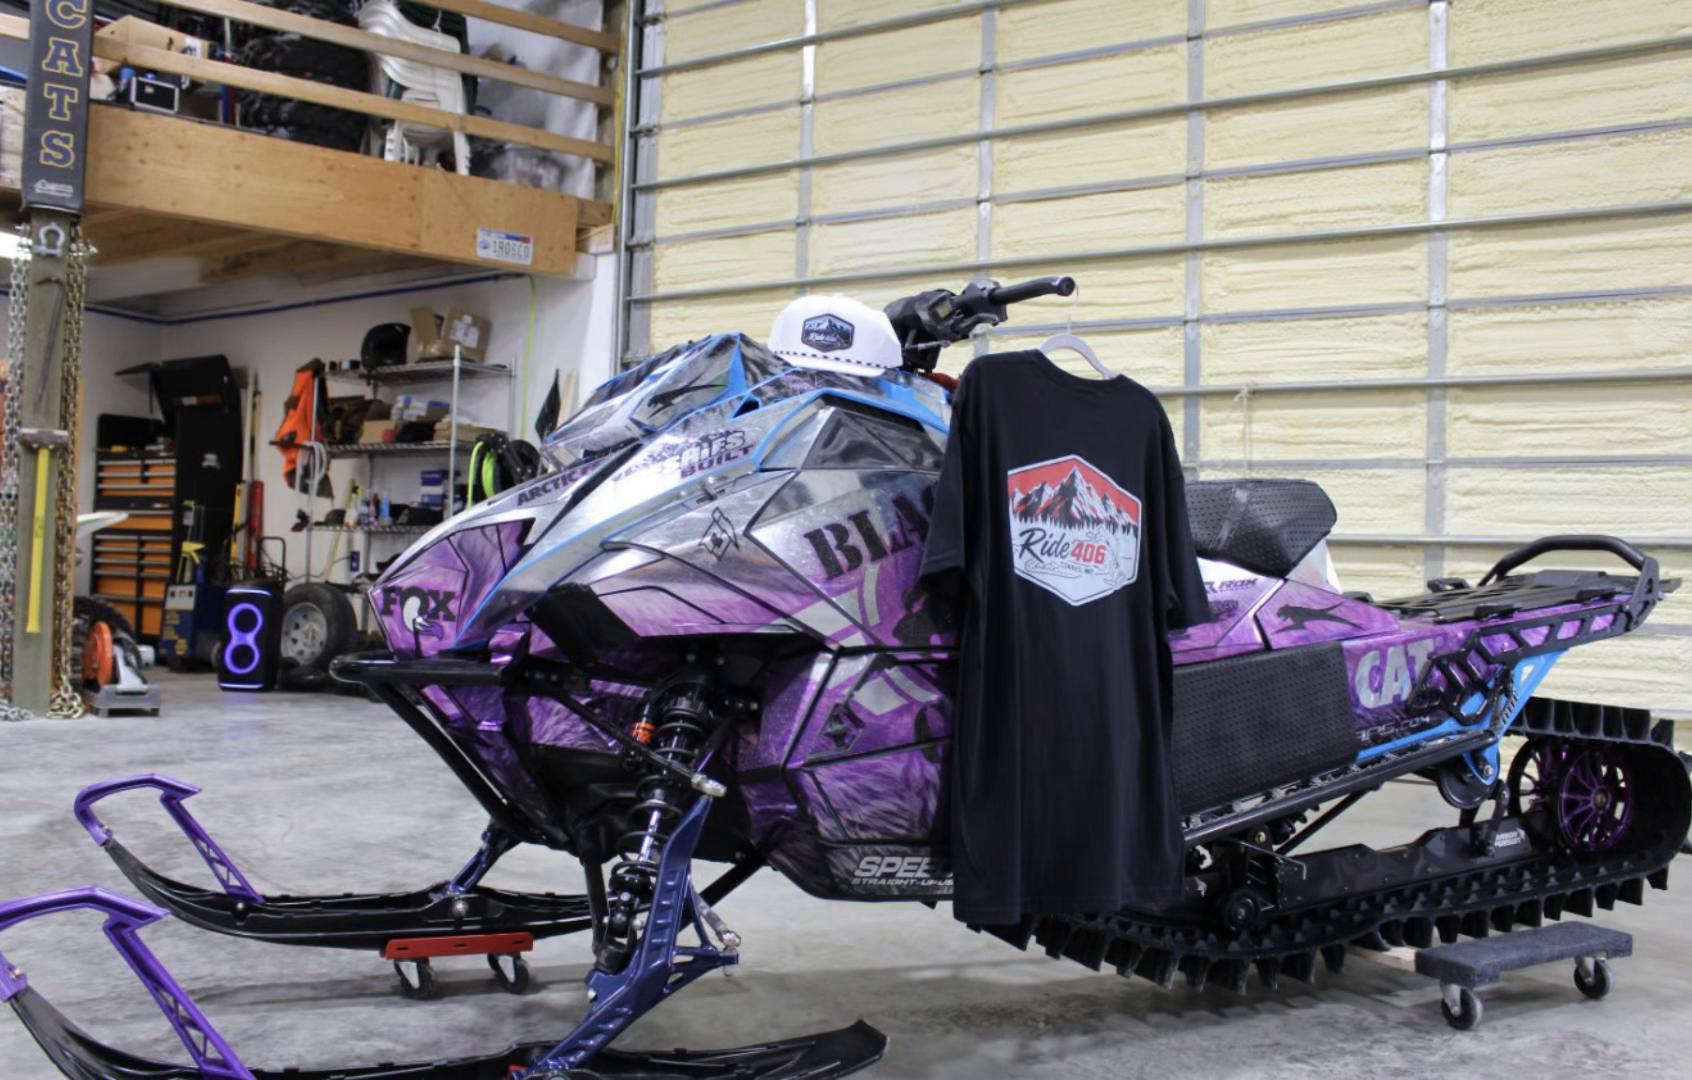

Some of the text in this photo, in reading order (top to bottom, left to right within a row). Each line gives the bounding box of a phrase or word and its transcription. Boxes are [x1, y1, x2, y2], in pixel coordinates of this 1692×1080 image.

[40, 0, 87, 168] CATS
[681, 444, 754, 479] BUILT
[517, 470, 580, 506] ARCTIC
[804, 481, 935, 580] BLA
[1019, 527, 1106, 565] Ride 406
[381, 586, 457, 632] FOX
[854, 855, 934, 878] SPEE
